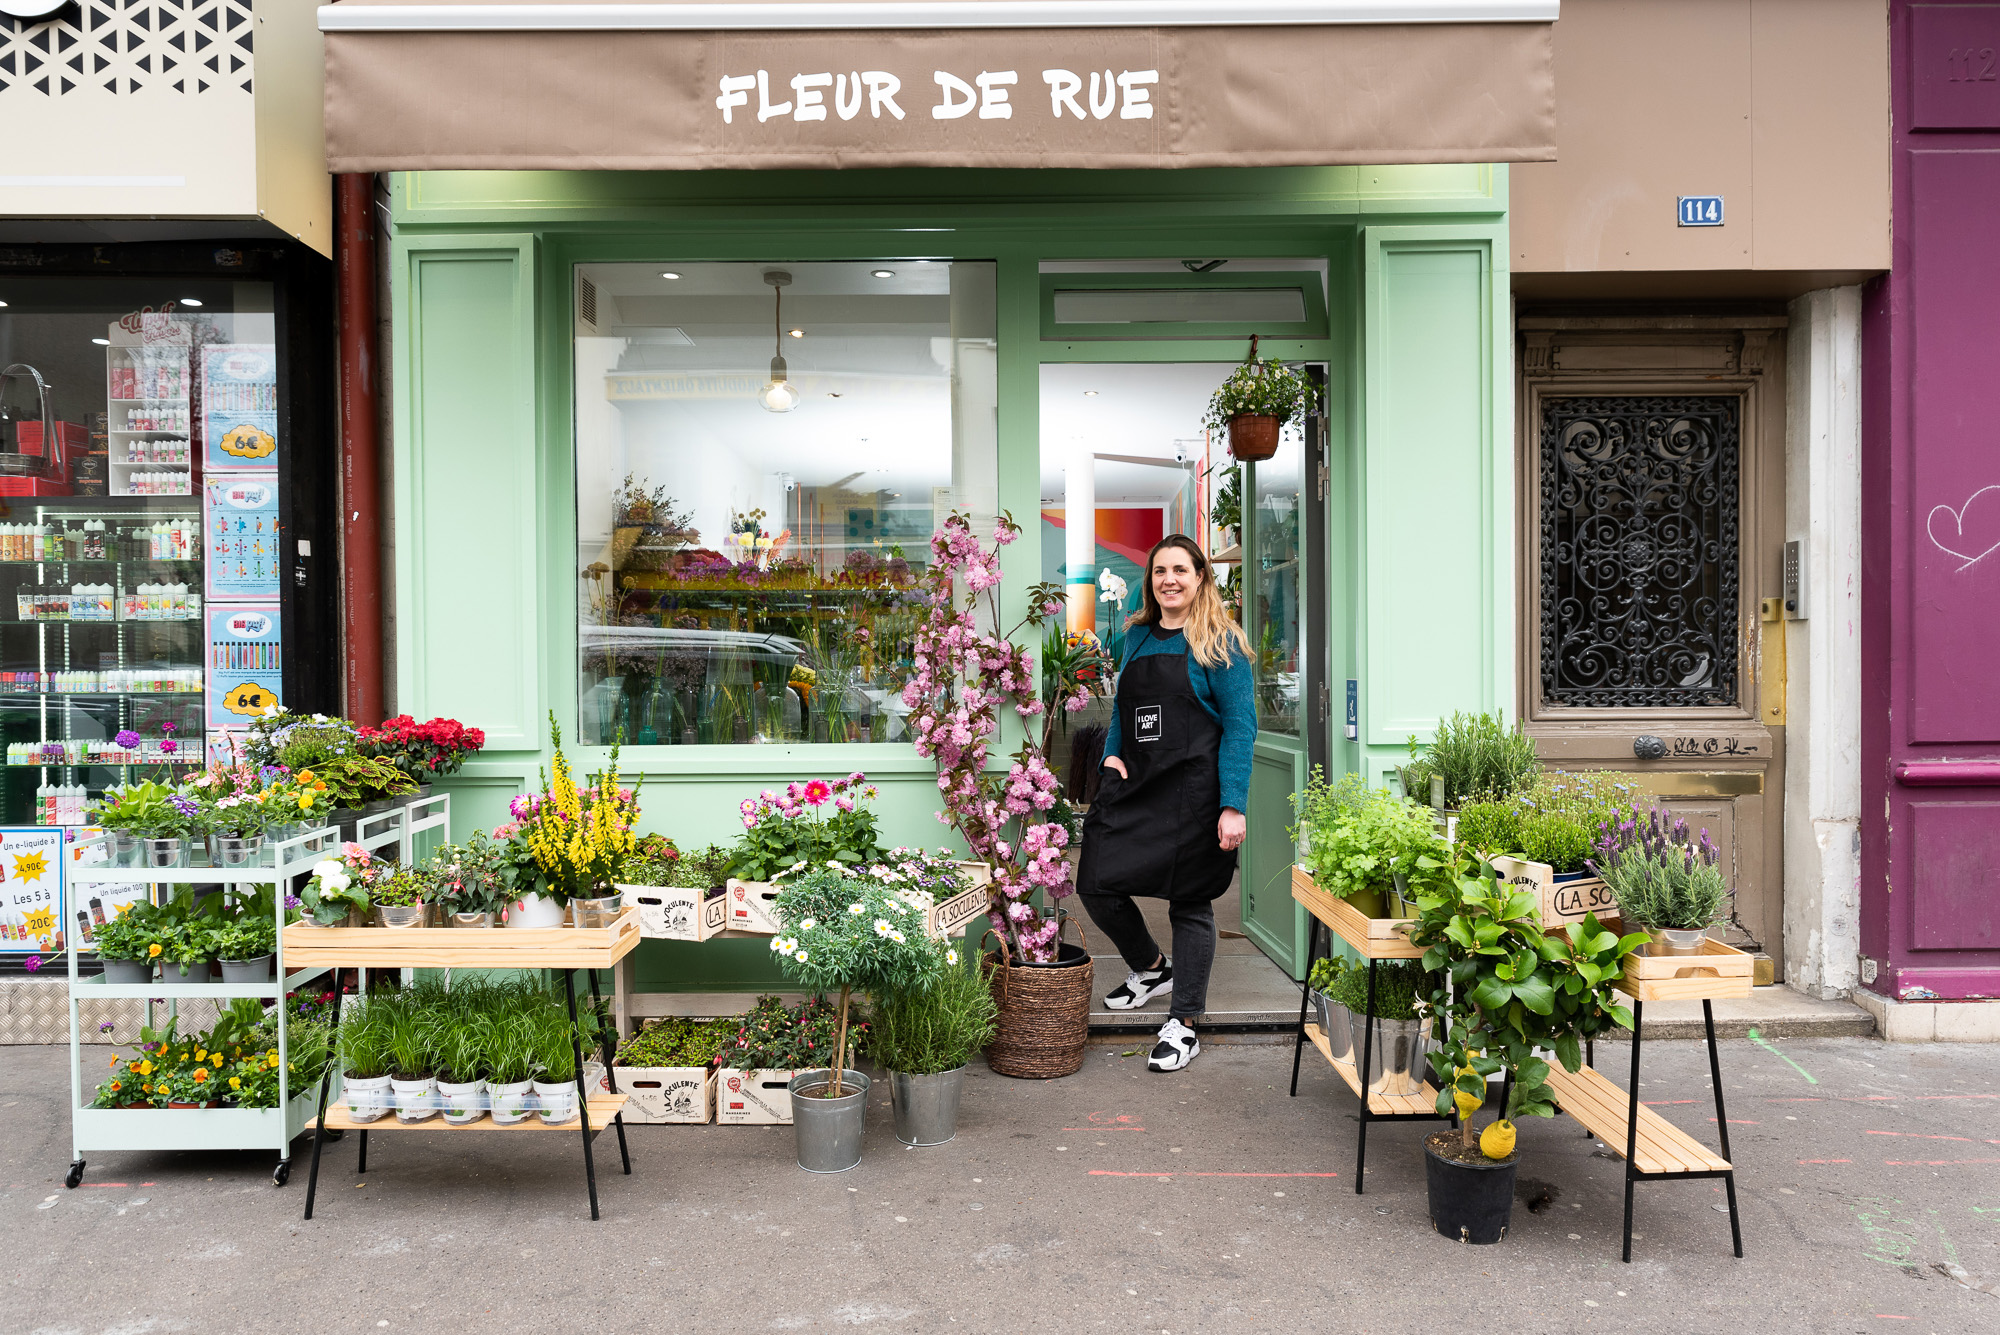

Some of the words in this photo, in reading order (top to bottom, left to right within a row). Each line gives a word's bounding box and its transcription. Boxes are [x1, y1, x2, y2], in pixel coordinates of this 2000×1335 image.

[1948, 47, 1997, 82] 112
[715, 69, 906, 124] FLEUR
[931, 70, 1018, 120] DE
[1042, 69, 1159, 120] RUE
[1686, 200, 1718, 221] 114
[235, 435, 258, 450] 6€
[233, 620, 246, 629] BIG
[238, 694, 261, 708] 6€
[1141, 714, 1158, 722] LOVE
[1141, 721, 1154, 729] ART
[3, 842, 14, 851] Un
[15, 839, 49, 850] e-liquide
[50, 836, 55, 845] à
[19, 861, 42, 874] 4,90€
[13, 893, 32, 905] Les
[35, 890, 41, 901] 5
[44, 888, 51, 900] à
[100, 889, 109, 897] Un
[109, 885, 132, 896] liquide
[937, 909, 947, 928] LA
[949, 888, 987, 922] SOCULENTE
[1559, 890, 1583, 911] LA
[663, 899, 695, 918] SOCULENTE
[708, 906, 722, 924] LA
[30, 916, 51, 930] 20€
[663, 1080, 700, 1101] SOCULENTE
[663, 1101, 673, 1112] LA
